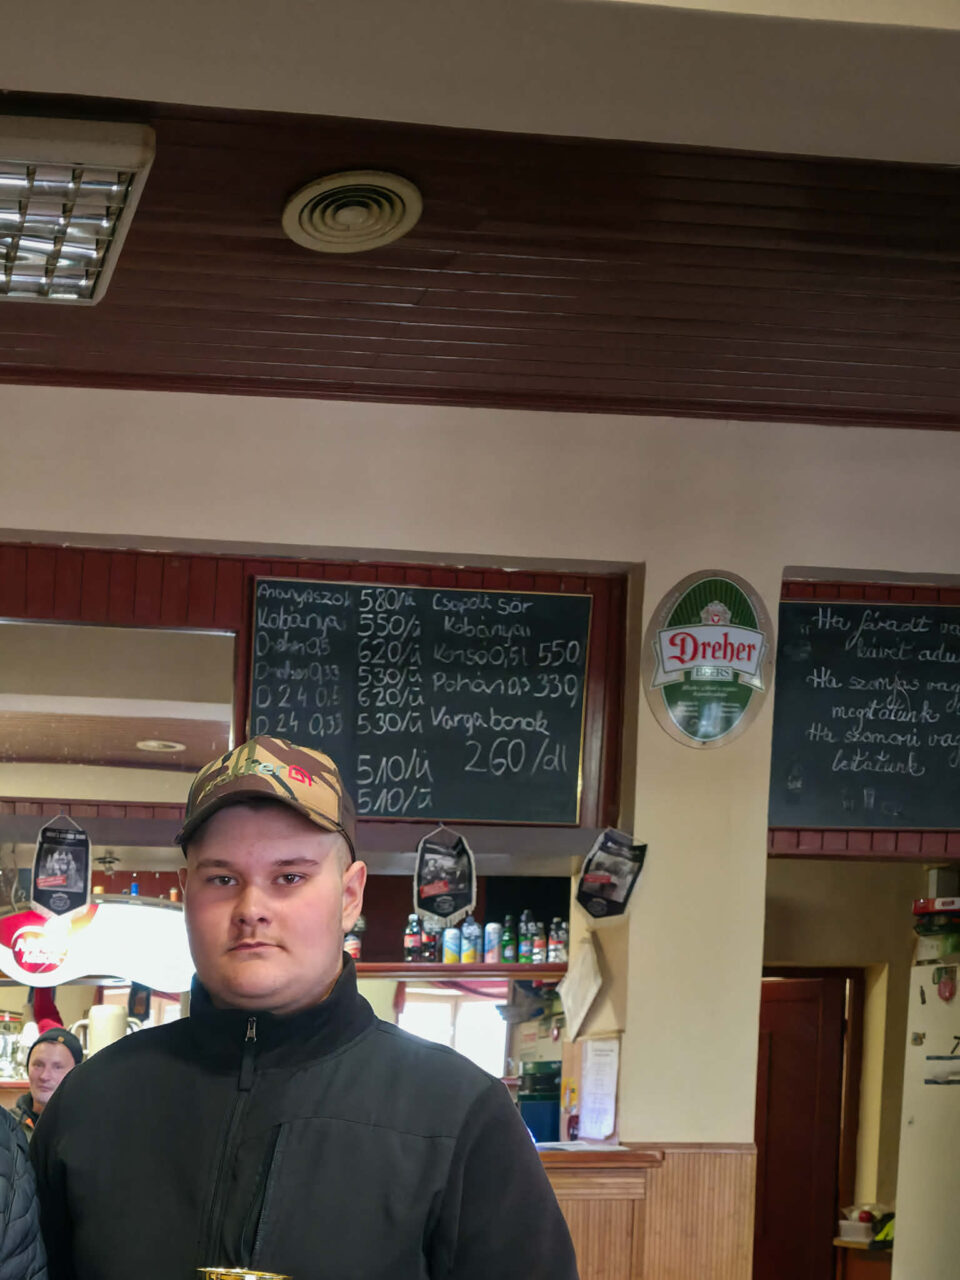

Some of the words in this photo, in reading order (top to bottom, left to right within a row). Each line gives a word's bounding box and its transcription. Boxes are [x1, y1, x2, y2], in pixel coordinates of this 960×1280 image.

[811, 607, 851, 631] Ha
[538, 639, 580, 666] 550
[667, 632, 756, 665] Dreher
[806, 666, 843, 688] Ha
[805, 722, 836, 743] Ha
